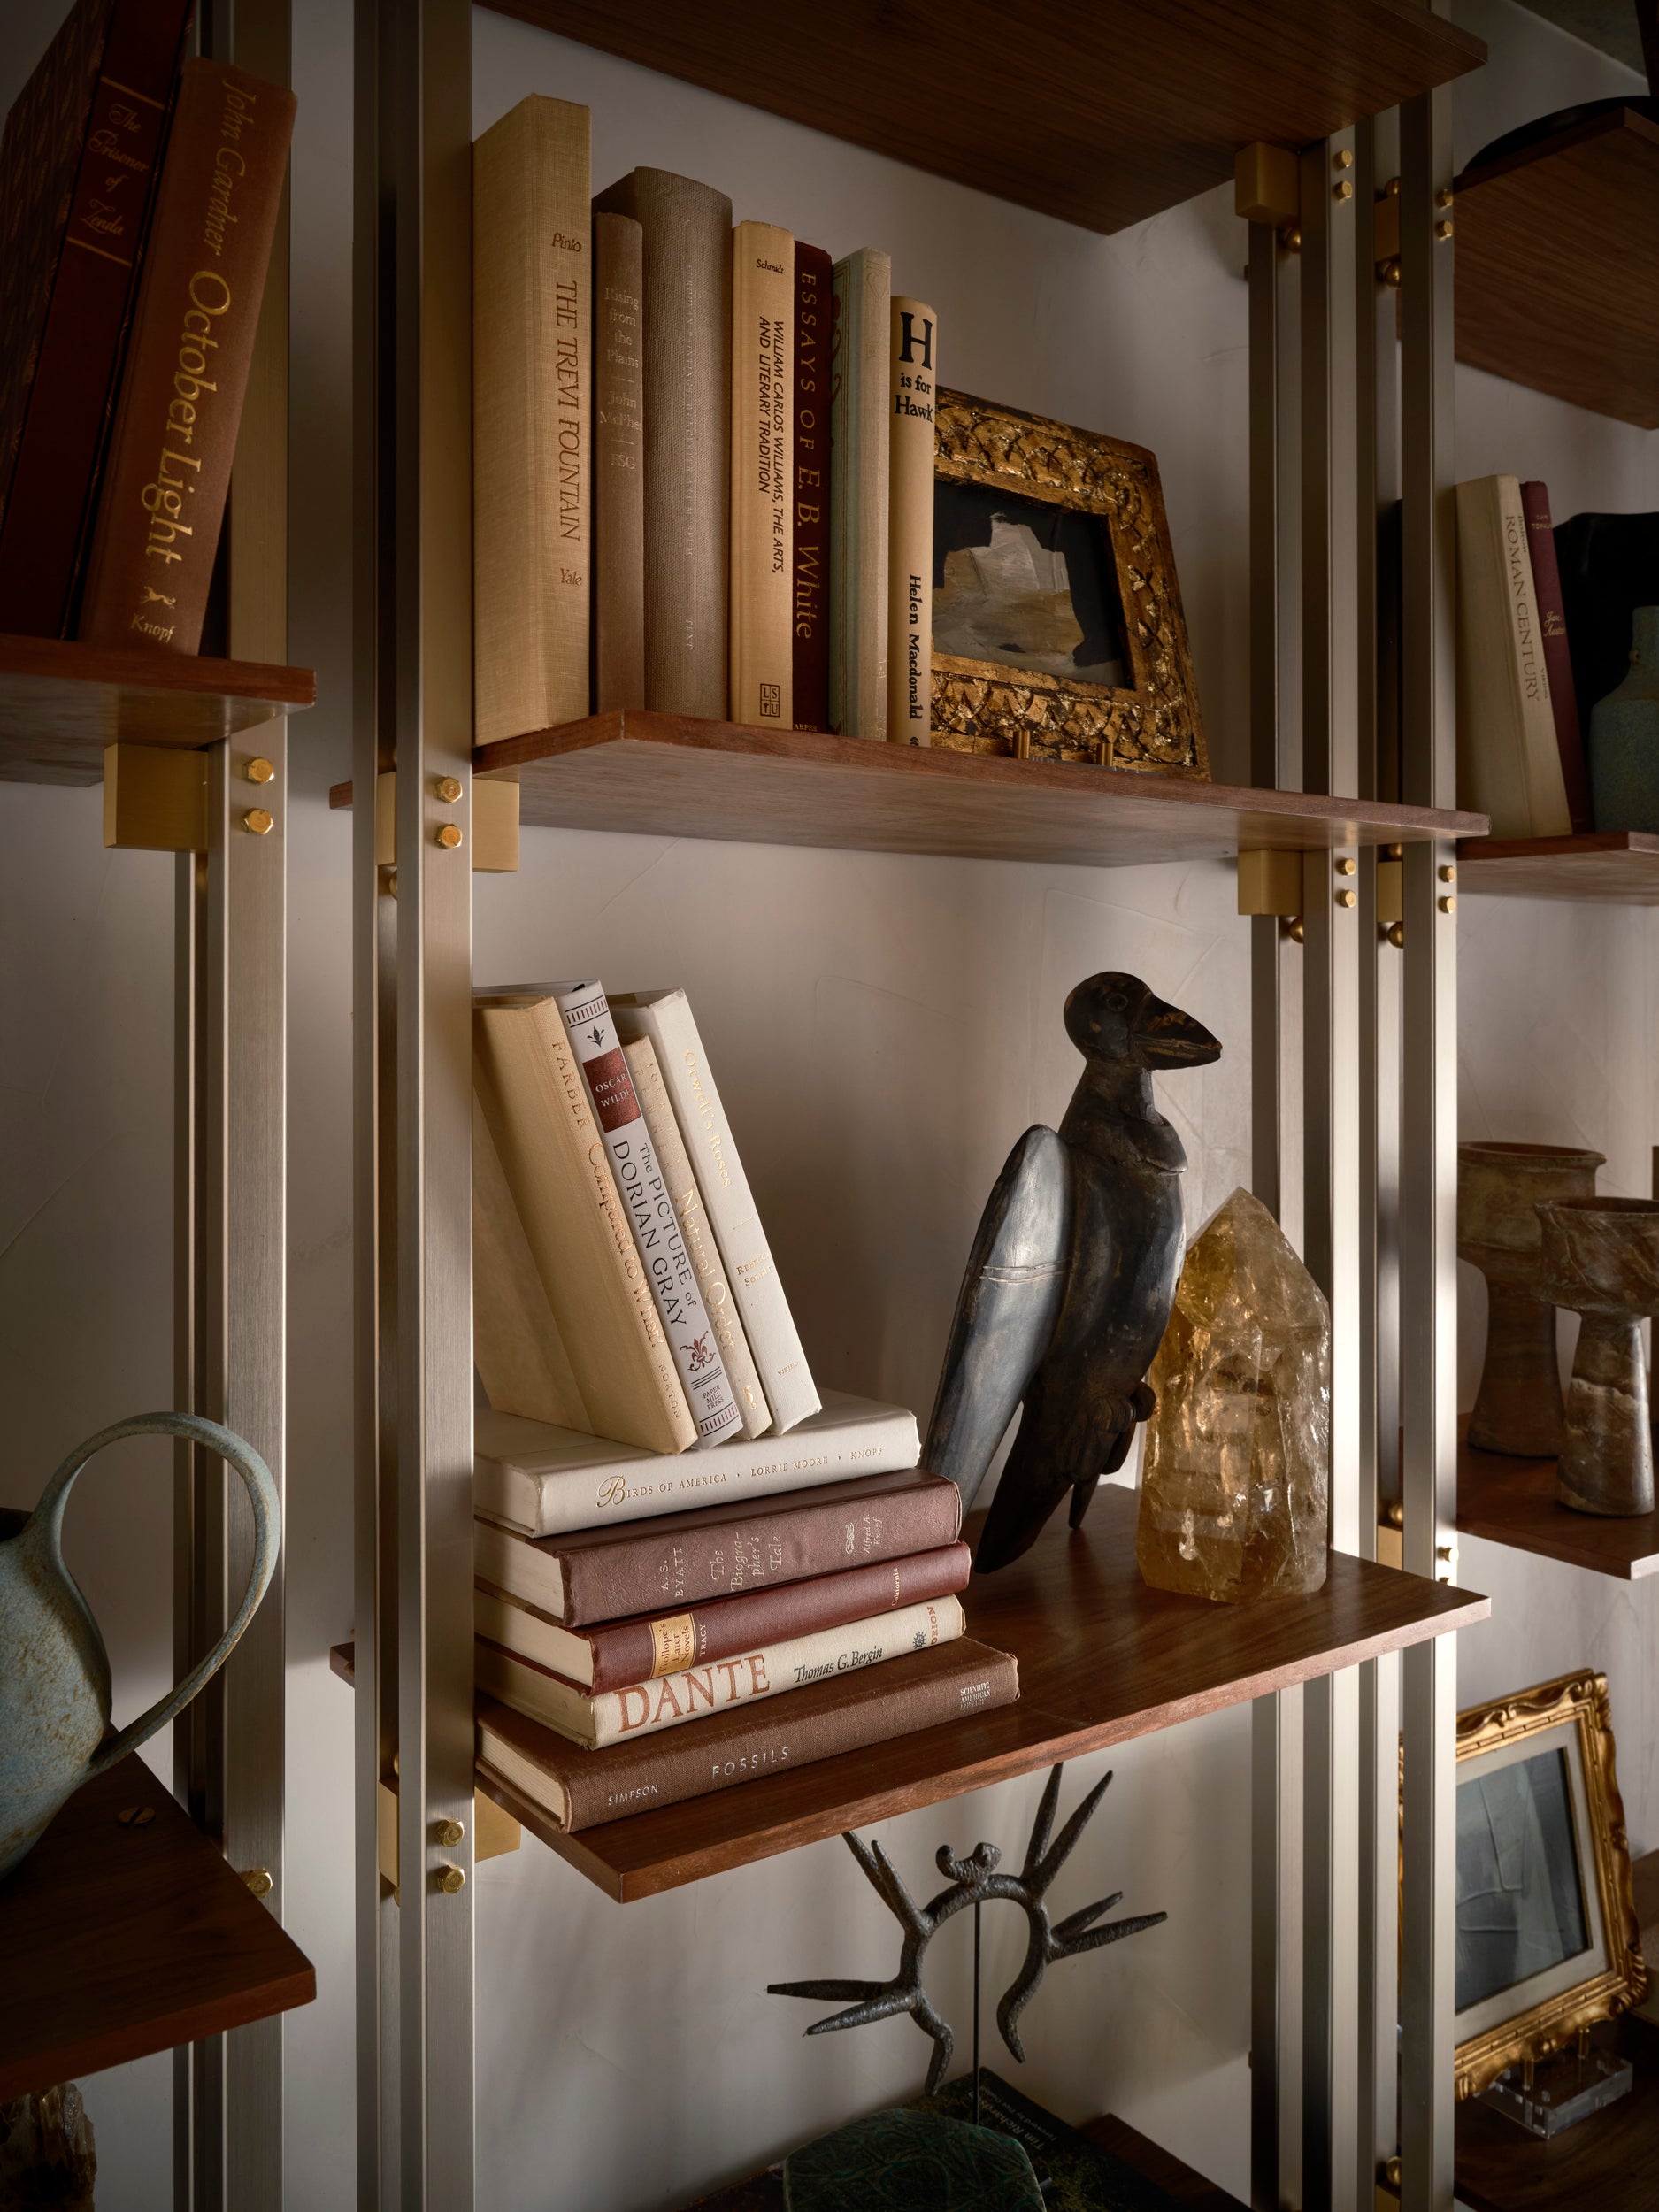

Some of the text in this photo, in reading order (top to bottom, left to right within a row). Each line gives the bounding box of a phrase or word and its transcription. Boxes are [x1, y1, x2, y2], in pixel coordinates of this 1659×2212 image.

[108, 104, 142, 132] The
[89, 130, 149, 172] Prisoner
[204, 80, 257, 256] John Gardner
[105, 174, 128, 192] of
[80, 199, 124, 236] Zenda
[550, 232, 581, 252] Pinto
[756, 258, 784, 275] Schmidt
[603, 287, 639, 311] Rising
[608, 308, 637, 326] from
[613, 328, 633, 346] the
[800, 272, 817, 393] ESSAYS
[899, 311, 933, 370] H
[605, 348, 640, 369] Plains
[607, 389, 637, 409] John
[900, 372, 932, 395] is for
[142, 270, 230, 565] October Light
[555, 280, 580, 541] THE TREVI FOUNTAIN
[759, 316, 771, 494] AND LITERARY TRADITION
[895, 394, 933, 423] Hawk
[772, 320, 784, 573] WILLIAM CARLOS WILLIAMS, THE ARTS,
[799, 409, 816, 450] OF
[610, 452, 636, 470] FSG
[559, 567, 582, 586] Yale
[796, 544, 821, 640] White
[130, 614, 176, 643] Knopf
[1506, 516, 1540, 702] ROMAN CENTURY
[908, 573, 923, 720] Helen Macdonald
[595, 1072, 627, 1093] OSCAR
[600, 1088, 633, 1108] WILDE
[635, 1069, 672, 1170] PENNER
[646, 1062, 682, 1163] JONATHAN
[684, 1049, 731, 1188] Orwell's Roses
[552, 1041, 590, 1130] FARBER
[588, 1142, 635, 1255] Compared
[625, 1256, 638, 1279] to
[613, 1140, 687, 1326] DORIAN GRAY
[640, 1142, 697, 1307] The PICTURE of
[673, 1187, 736, 1350] Natural Order
[778, 1361, 799, 1376] VIKING
[657, 1363, 682, 1419] NORTON
[702, 1384, 721, 1400] PAPER
[706, 1391, 722, 1404] MILL
[707, 1396, 725, 1410] PRESS
[658, 1482, 673, 1494] OF
[679, 1473, 727, 1490] AMERICA
[750, 1463, 788, 1477] LORRIE
[793, 1456, 828, 1470] MOORE
[850, 1447, 883, 1460] KNOPF
[863, 1526, 873, 1554] Alfred
[872, 1517, 883, 1546] Knopf
[710, 1549, 725, 1581] The
[730, 1532, 748, 1592] Biogra-
[747, 1536, 765, 1578] pher's
[768, 1535, 782, 1571] Tale
[673, 1548, 684, 1598] BYATT
[891, 1568, 901, 1607] California
[680, 1625, 691, 1663] Novels
[926, 1606, 939, 1645] ORION
[658, 1623, 672, 1674] Trollope's
[672, 1633, 680, 1663] Later
[614, 1646, 883, 1734] DANTE Thomas G. Bergin
[960, 1681, 990, 1697] SCIENTIFIC
[607, 1745, 791, 1807] SIMPSON FOSSILS
